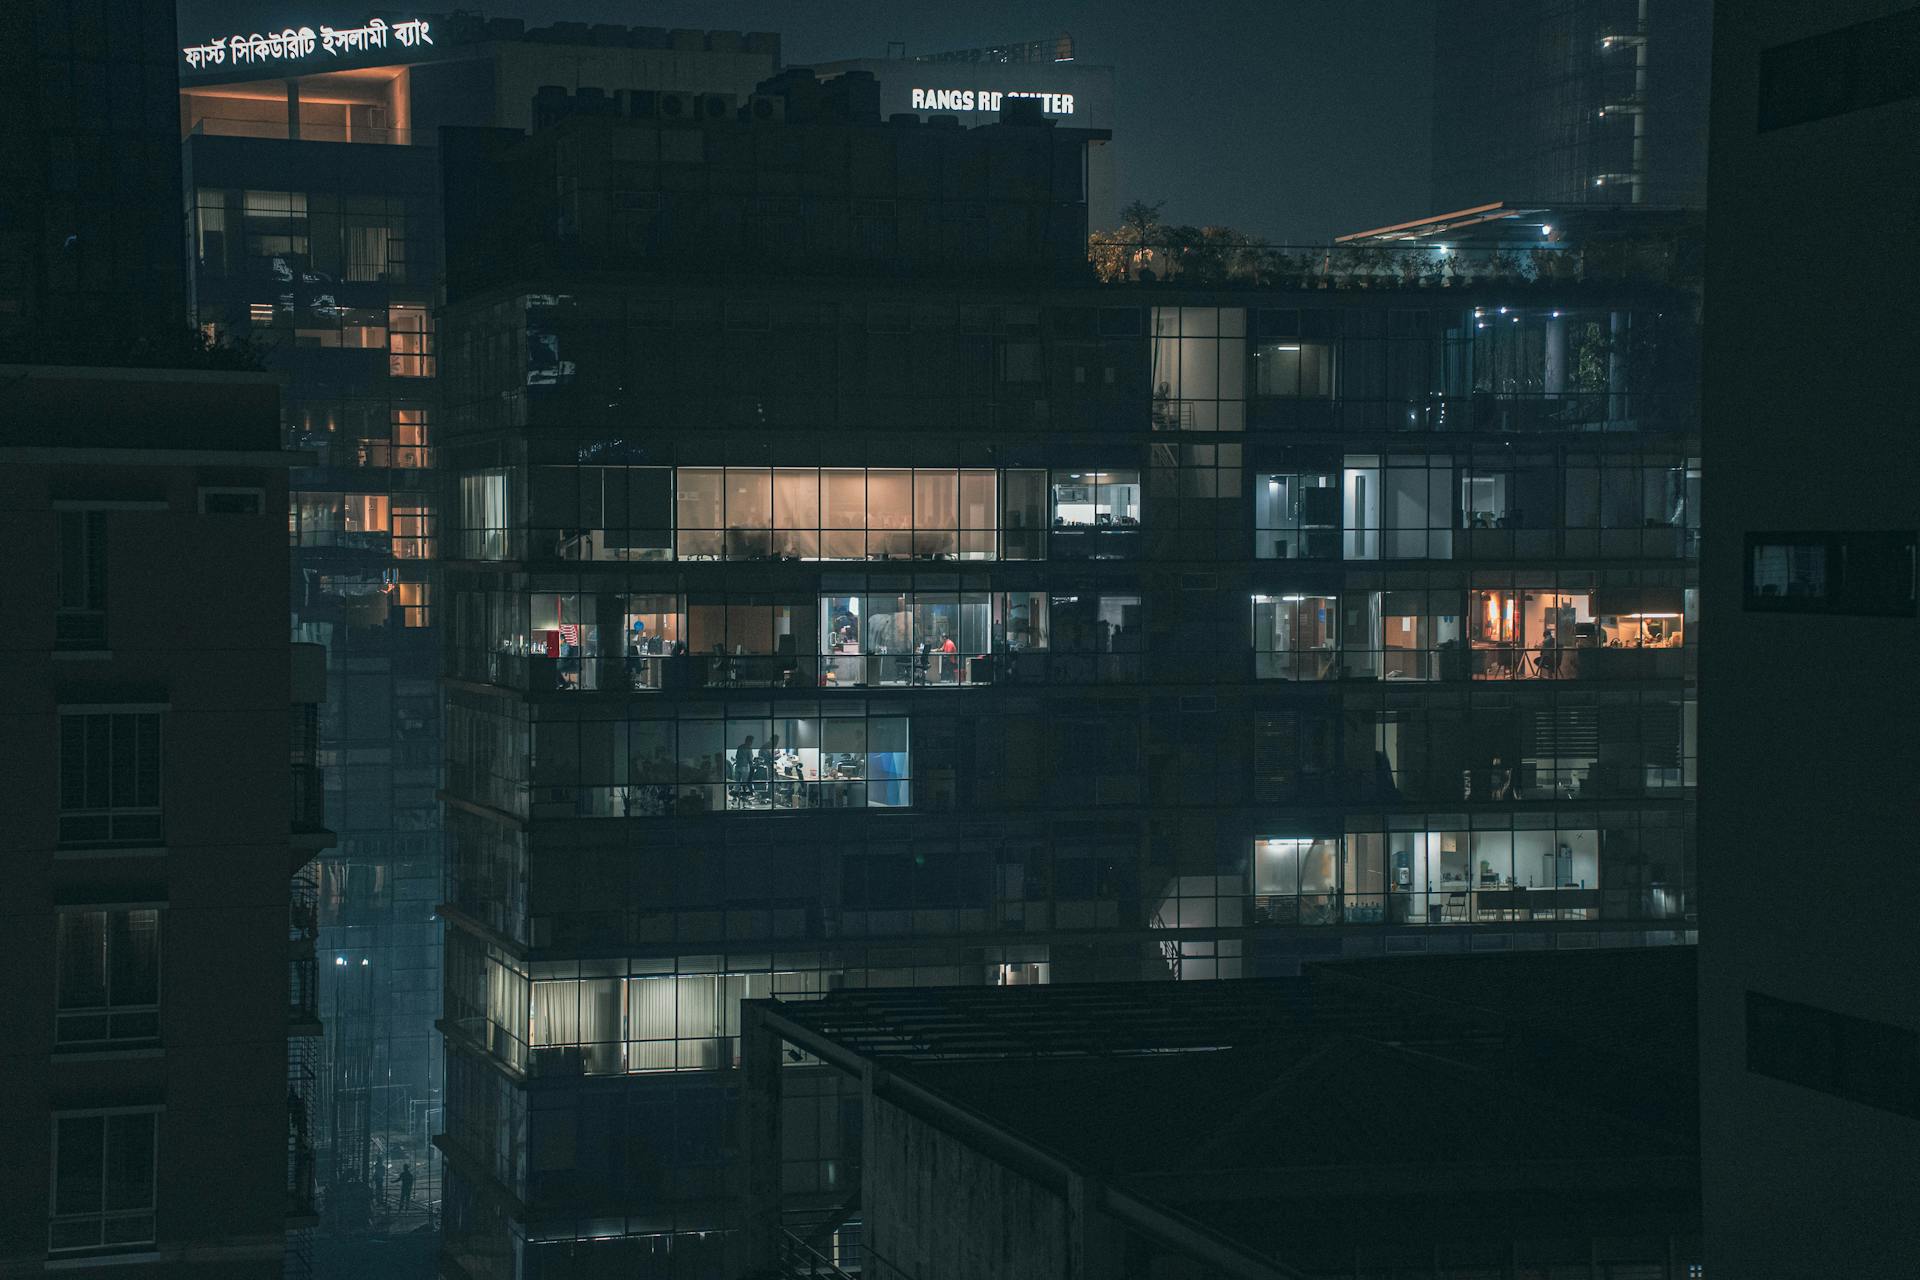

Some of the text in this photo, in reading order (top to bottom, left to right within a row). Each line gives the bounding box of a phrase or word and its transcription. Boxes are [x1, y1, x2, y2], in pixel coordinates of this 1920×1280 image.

[182, 36, 228, 69] ফার্স্ট
[229, 27, 317, 65] সিকিউরিটি
[320, 17, 389, 57] ইসলামী
[911, 88, 975, 111] RANGS
[1007, 91, 1074, 115] TER
